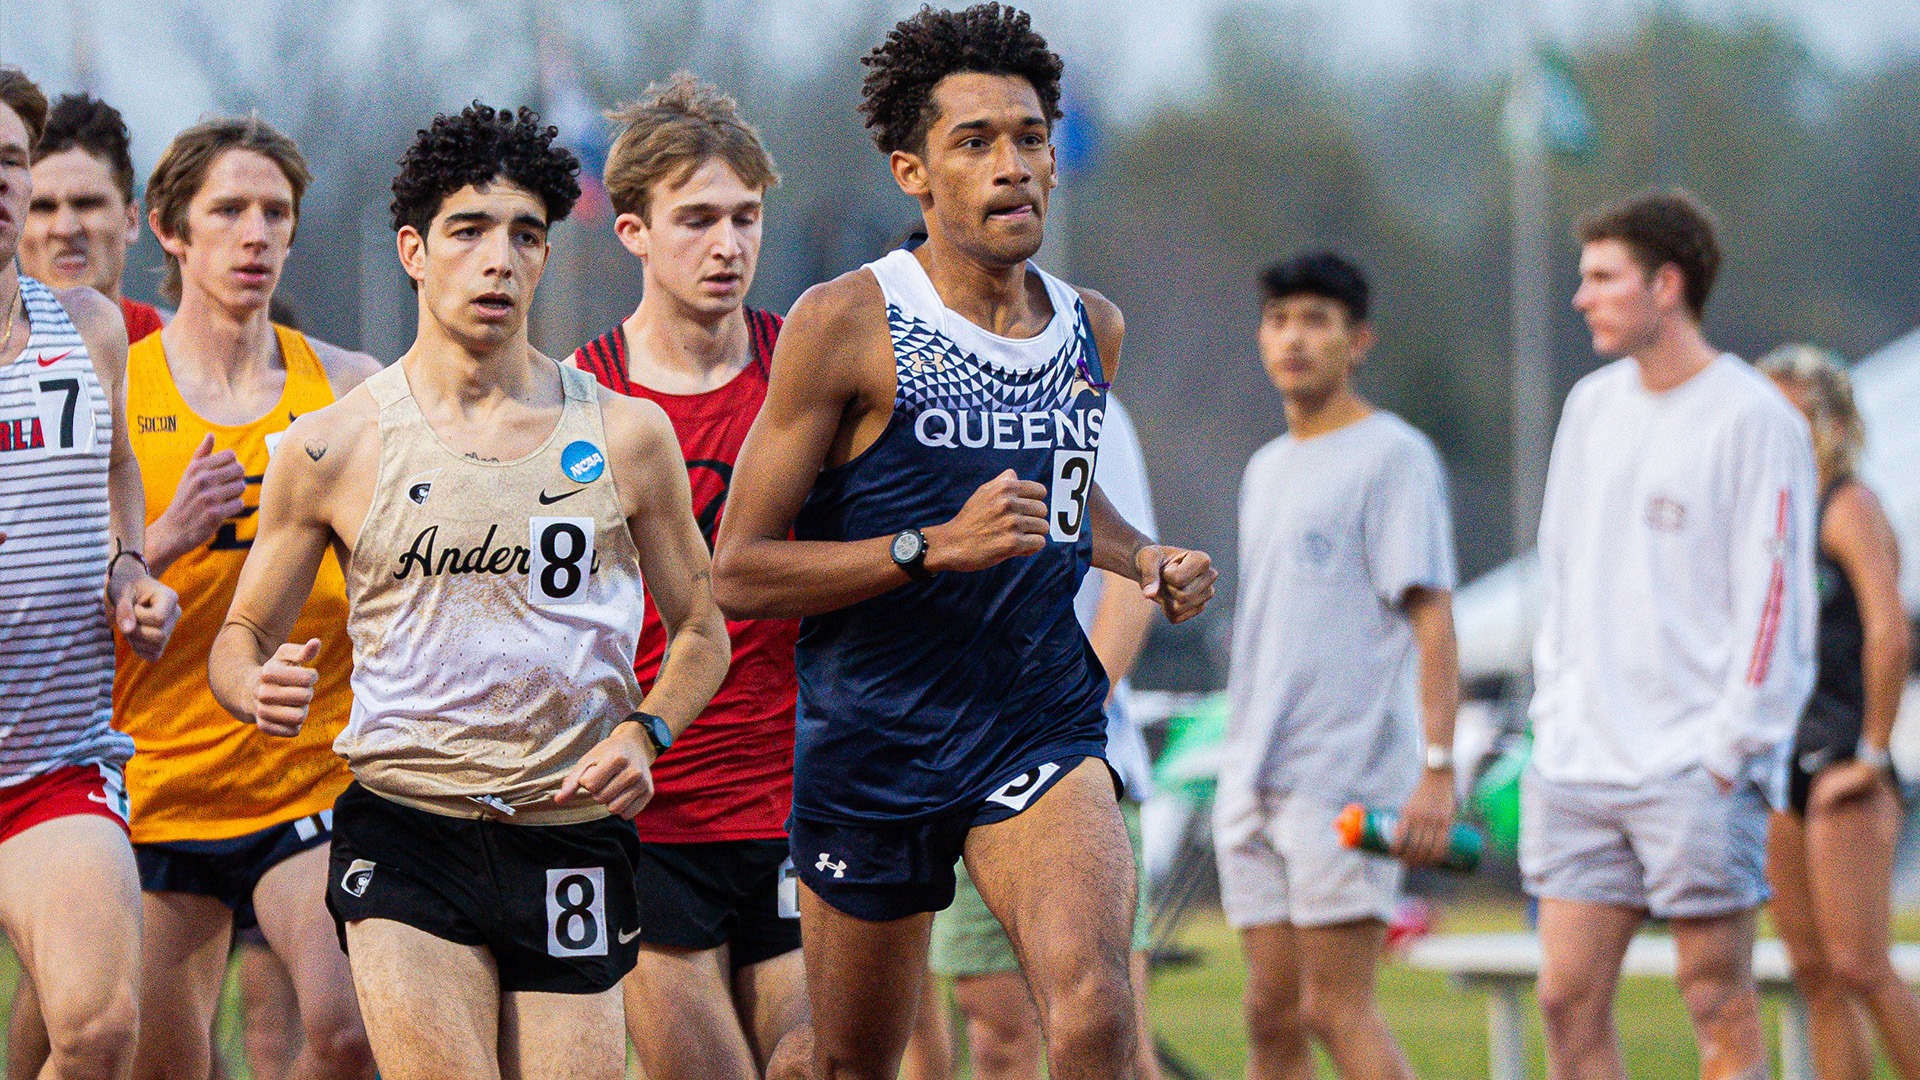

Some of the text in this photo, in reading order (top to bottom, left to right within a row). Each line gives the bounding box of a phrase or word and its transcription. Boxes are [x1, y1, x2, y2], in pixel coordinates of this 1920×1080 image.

[39, 378, 80, 448] 7
[137, 414, 177, 434] SOCON
[914, 408, 1105, 449] QUEENS
[570, 452, 604, 478] NCAA
[1057, 456, 1090, 536] 3
[540, 522, 587, 599] 8
[555, 873, 598, 950] 8
